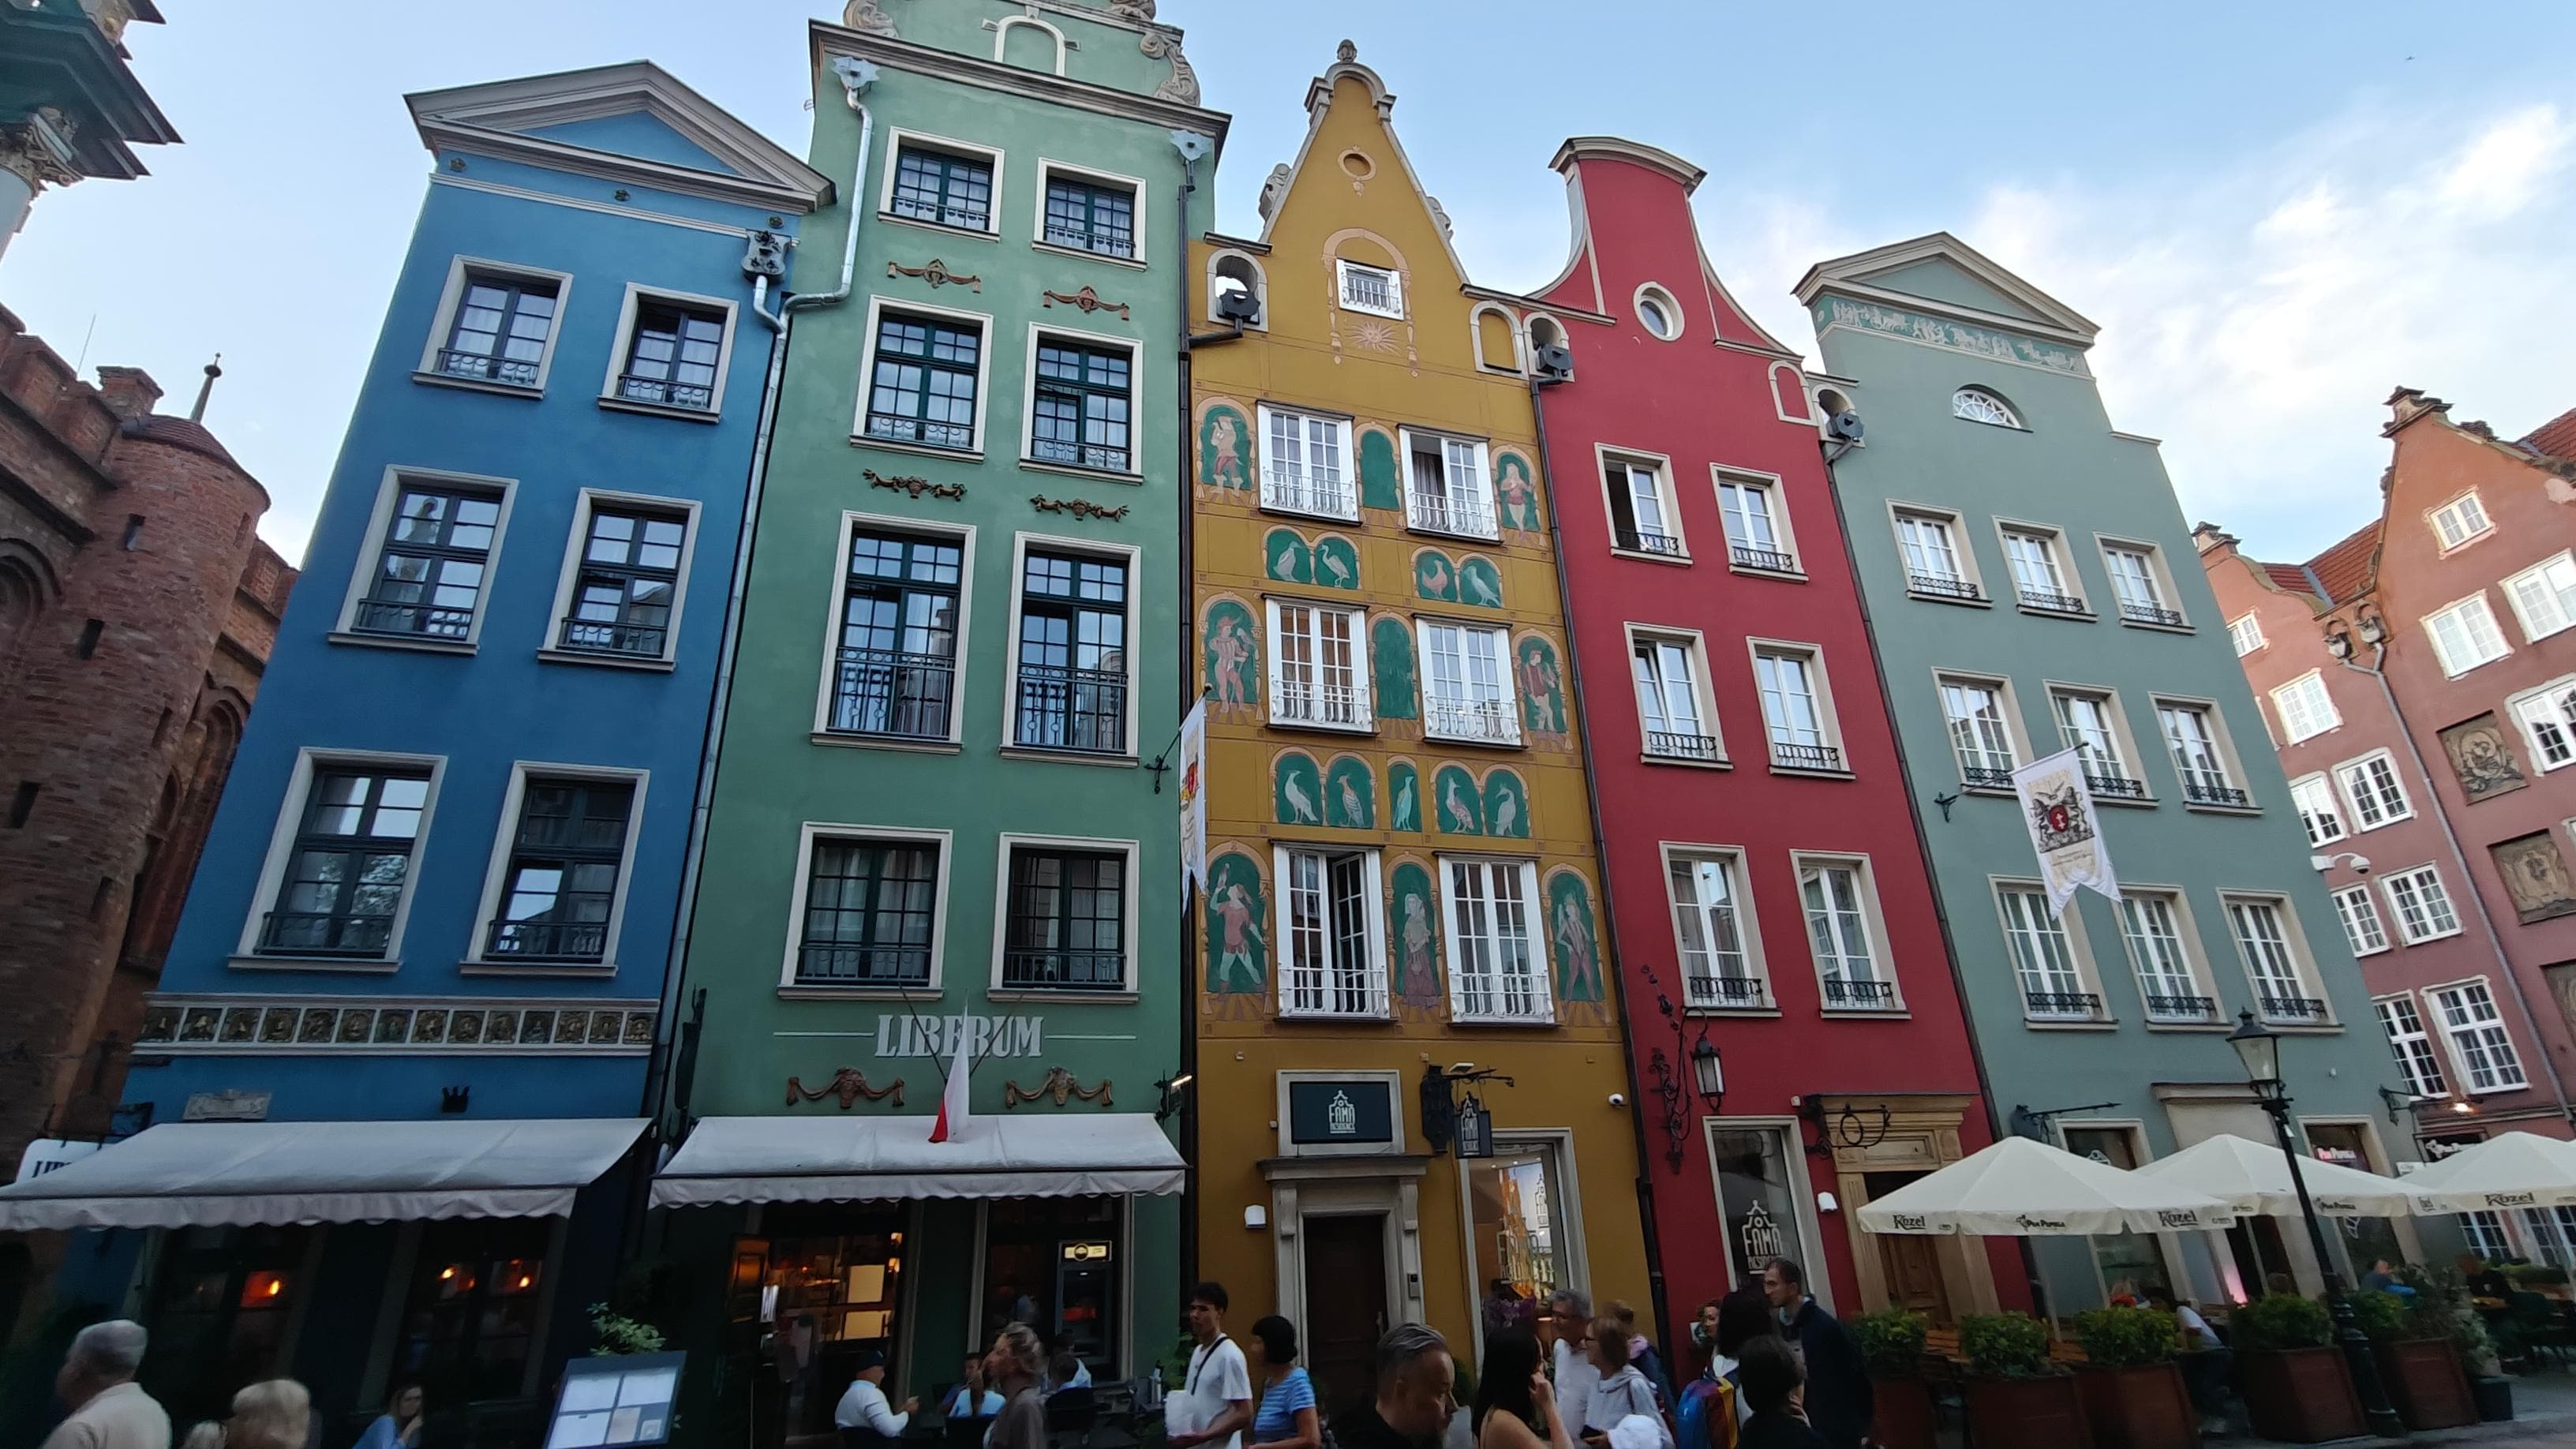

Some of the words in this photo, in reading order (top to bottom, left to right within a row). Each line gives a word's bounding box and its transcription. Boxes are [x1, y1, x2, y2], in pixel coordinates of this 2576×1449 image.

[874, 1014, 1044, 1058] LIBERUM
[1328, 1104, 1356, 1123] FAMA
[2484, 1192, 2535, 1207] Kozel
[1893, 1215, 1926, 1230] Kozel
[2157, 1210, 2199, 1227] Kozel
[1742, 1225, 1784, 1256] FAMA
